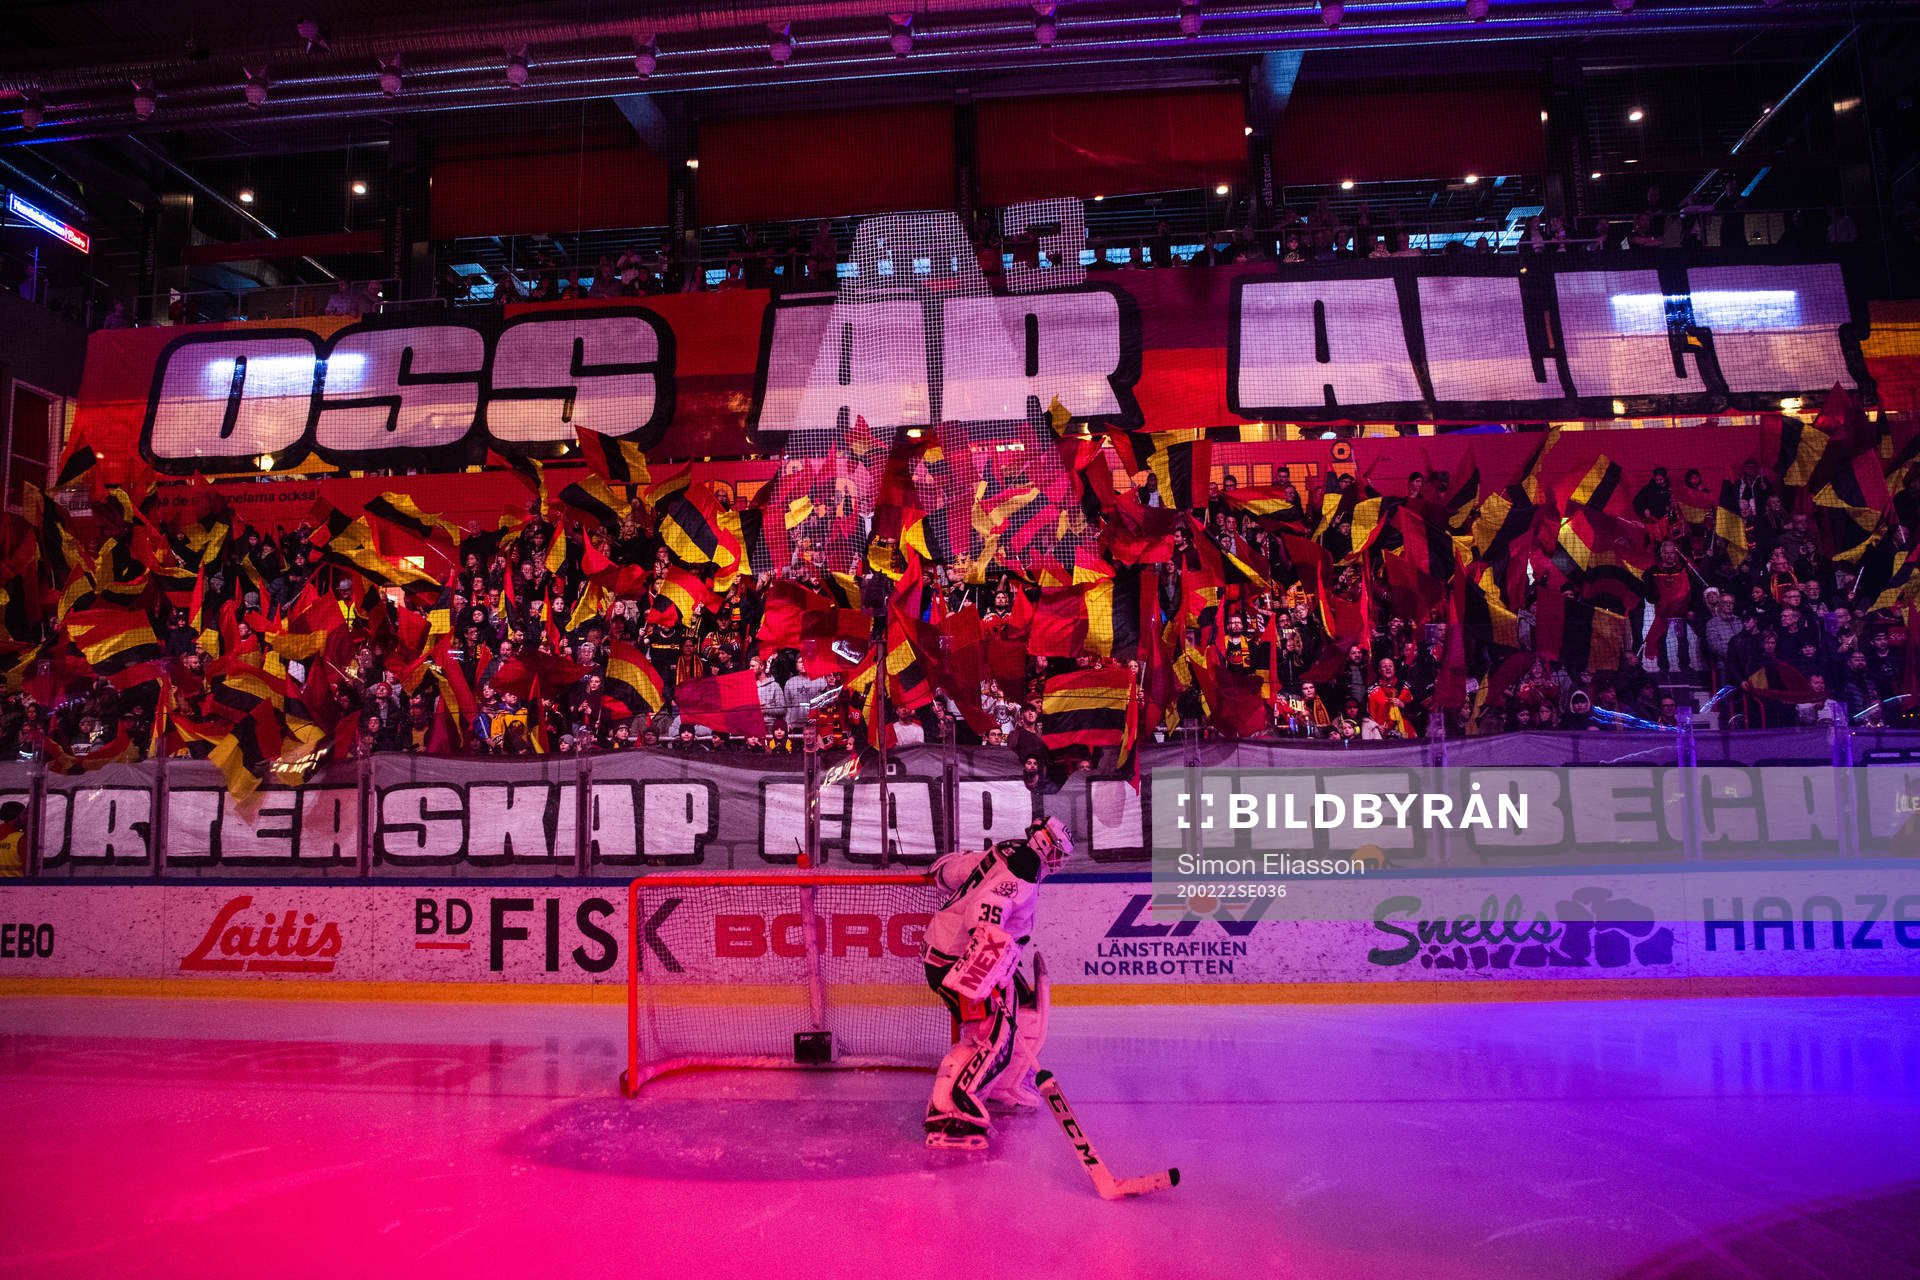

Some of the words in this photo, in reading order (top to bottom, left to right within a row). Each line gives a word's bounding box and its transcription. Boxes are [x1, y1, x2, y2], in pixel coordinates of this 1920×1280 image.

[1262, 153, 1274, 207] stålstaden
[145, 309, 668, 470] OSS
[1234, 258, 1866, 413] ALLT
[0, 923, 55, 959] EBO
[180, 896, 342, 972] Laitis
[415, 898, 473, 935] BD
[490, 897, 686, 973] FISK
[715, 912, 936, 958] BORG
[978, 903, 1003, 925] 35
[1367, 895, 1563, 967] Snells
[959, 933, 1006, 992] MEX
[1084, 960, 1234, 976] NORRBOTTEN
[1097, 938, 1248, 958] LÄNSTRAFIKEN
[1048, 1092, 1100, 1168] CCM
